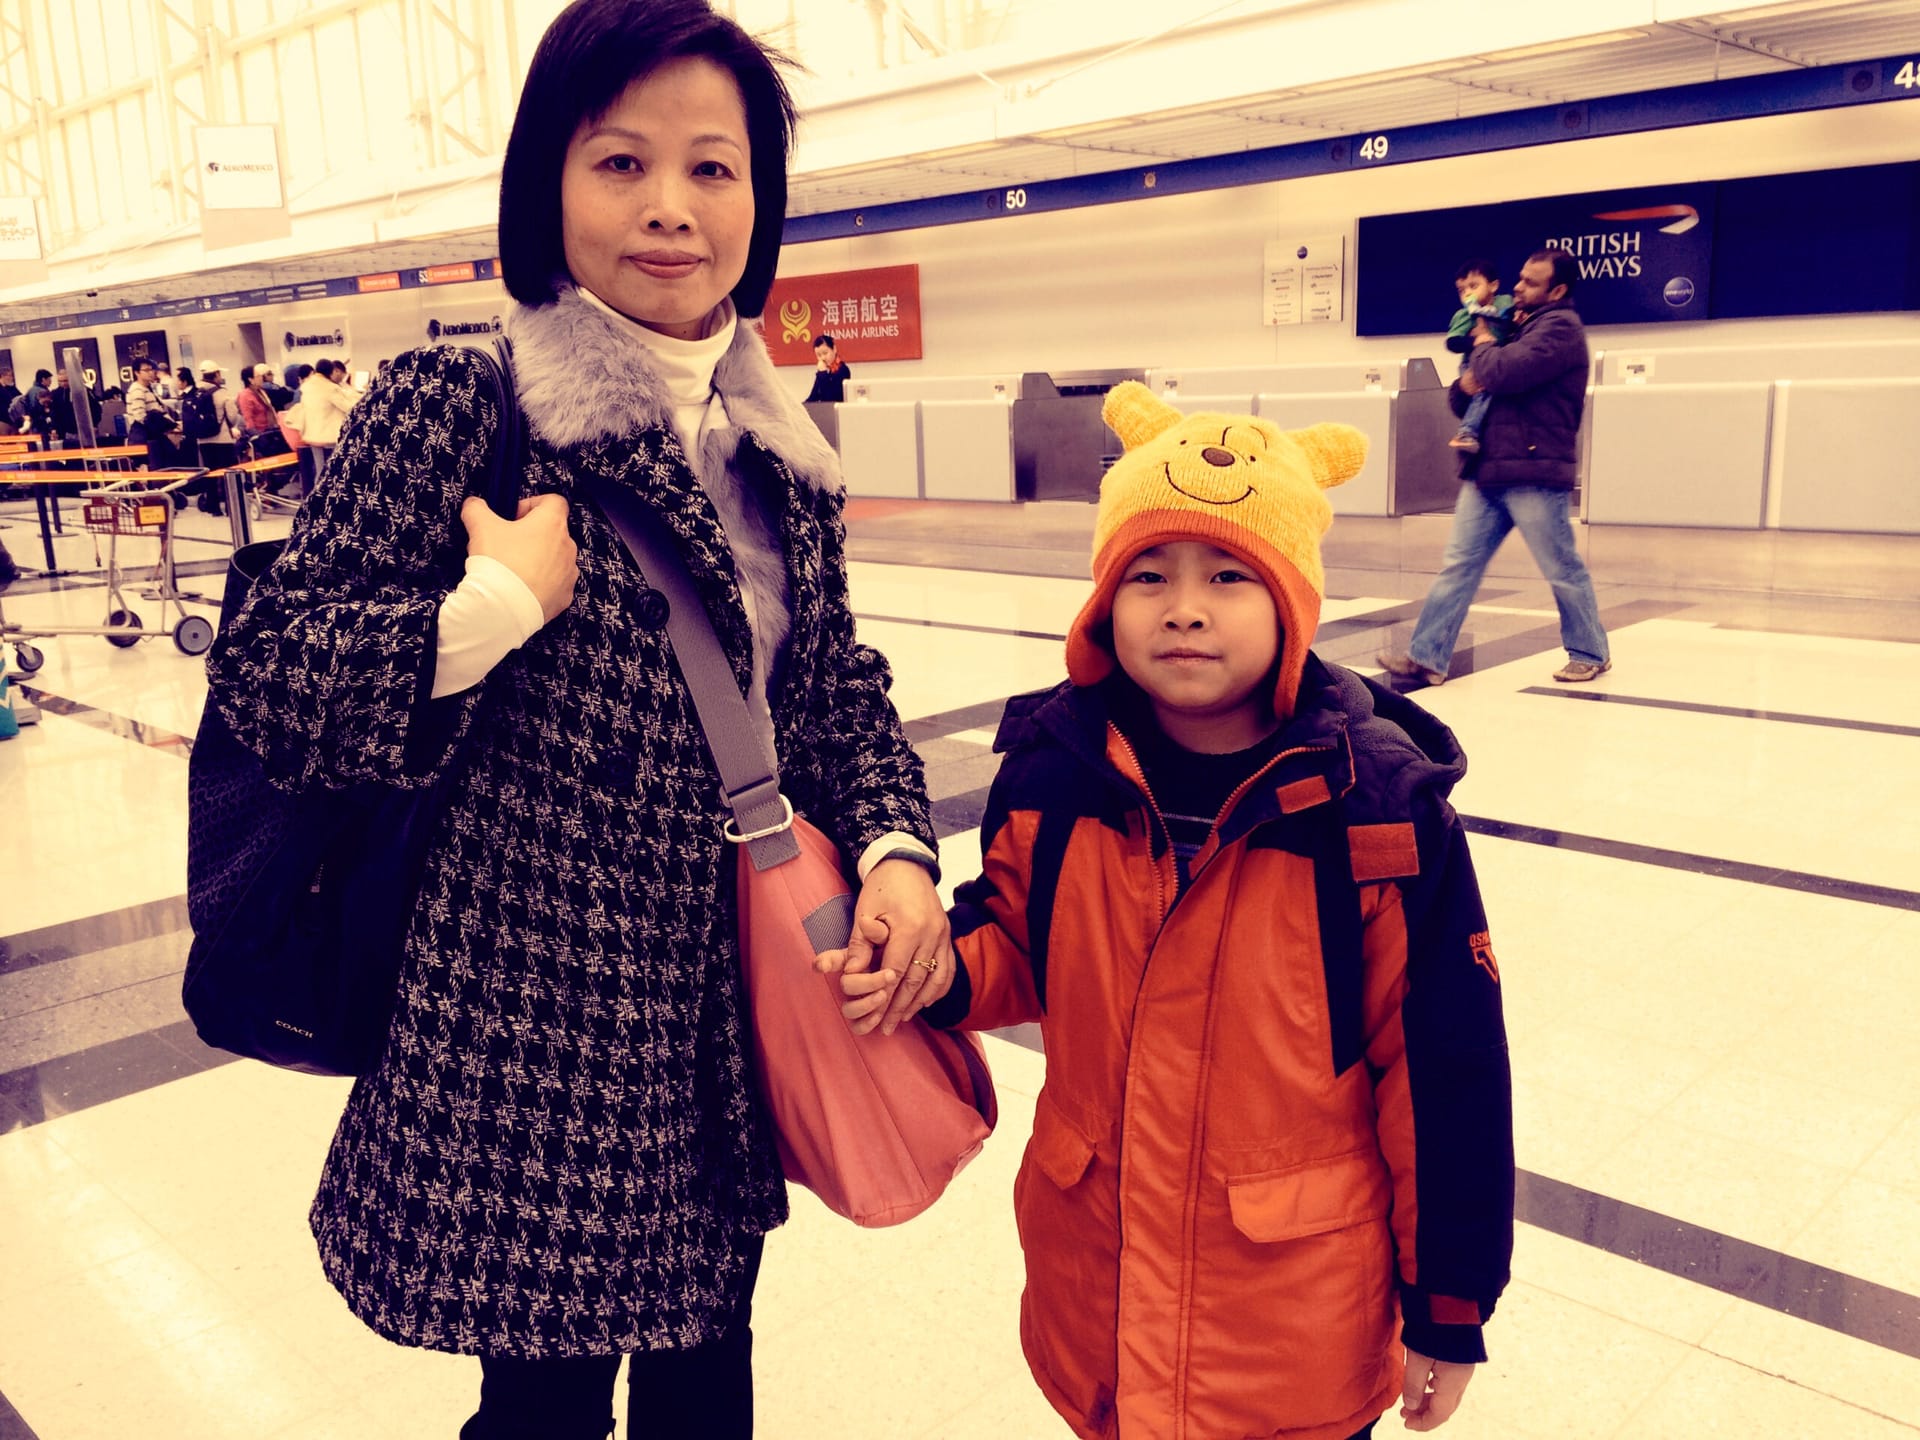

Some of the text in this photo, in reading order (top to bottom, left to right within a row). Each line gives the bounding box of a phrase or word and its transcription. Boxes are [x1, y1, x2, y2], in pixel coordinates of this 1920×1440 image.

[1894, 61, 1920, 88] 4
[1360, 136, 1388, 160] 49
[1006, 189, 1026, 209] 50
[1577, 255, 1642, 281] WAYS
[822, 295, 898, 326] 海南航空
[824, 325, 899, 339] HAINAN AIRLINES
[275, 1020, 313, 1038] COACH
